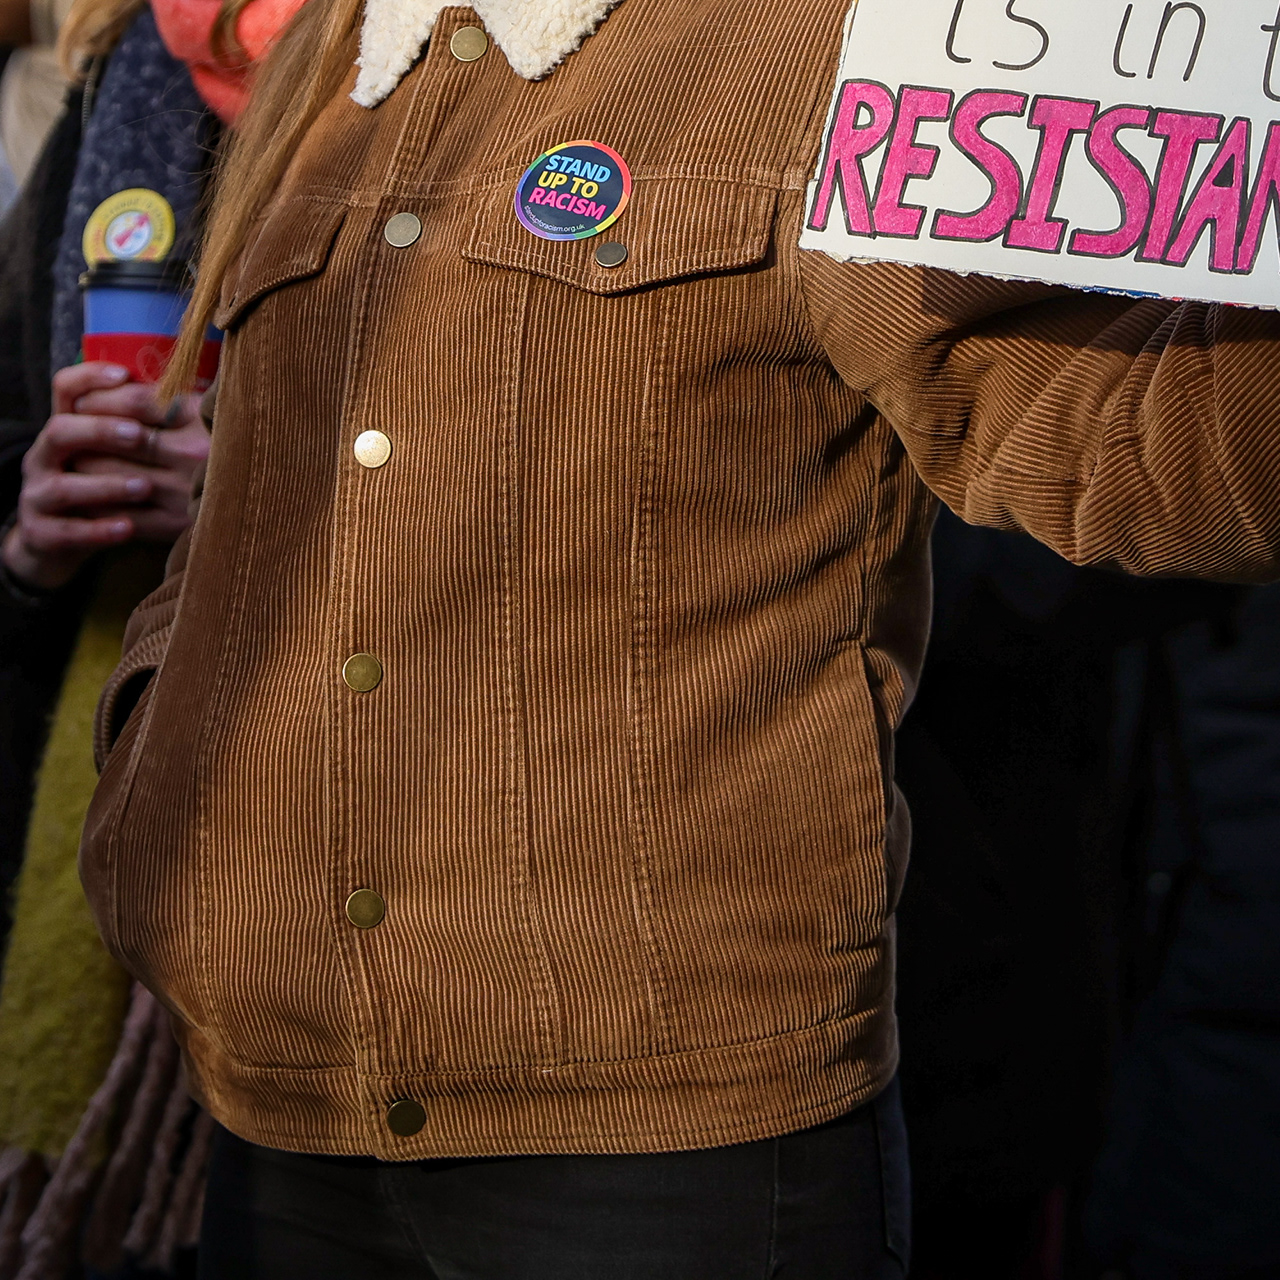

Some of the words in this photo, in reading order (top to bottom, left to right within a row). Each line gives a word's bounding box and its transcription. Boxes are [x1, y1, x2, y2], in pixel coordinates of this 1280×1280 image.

[545, 154, 611, 183] STAND
[537, 170, 568, 190] UP
[570, 176, 599, 199] TO
[528, 187, 608, 221] RACISM
